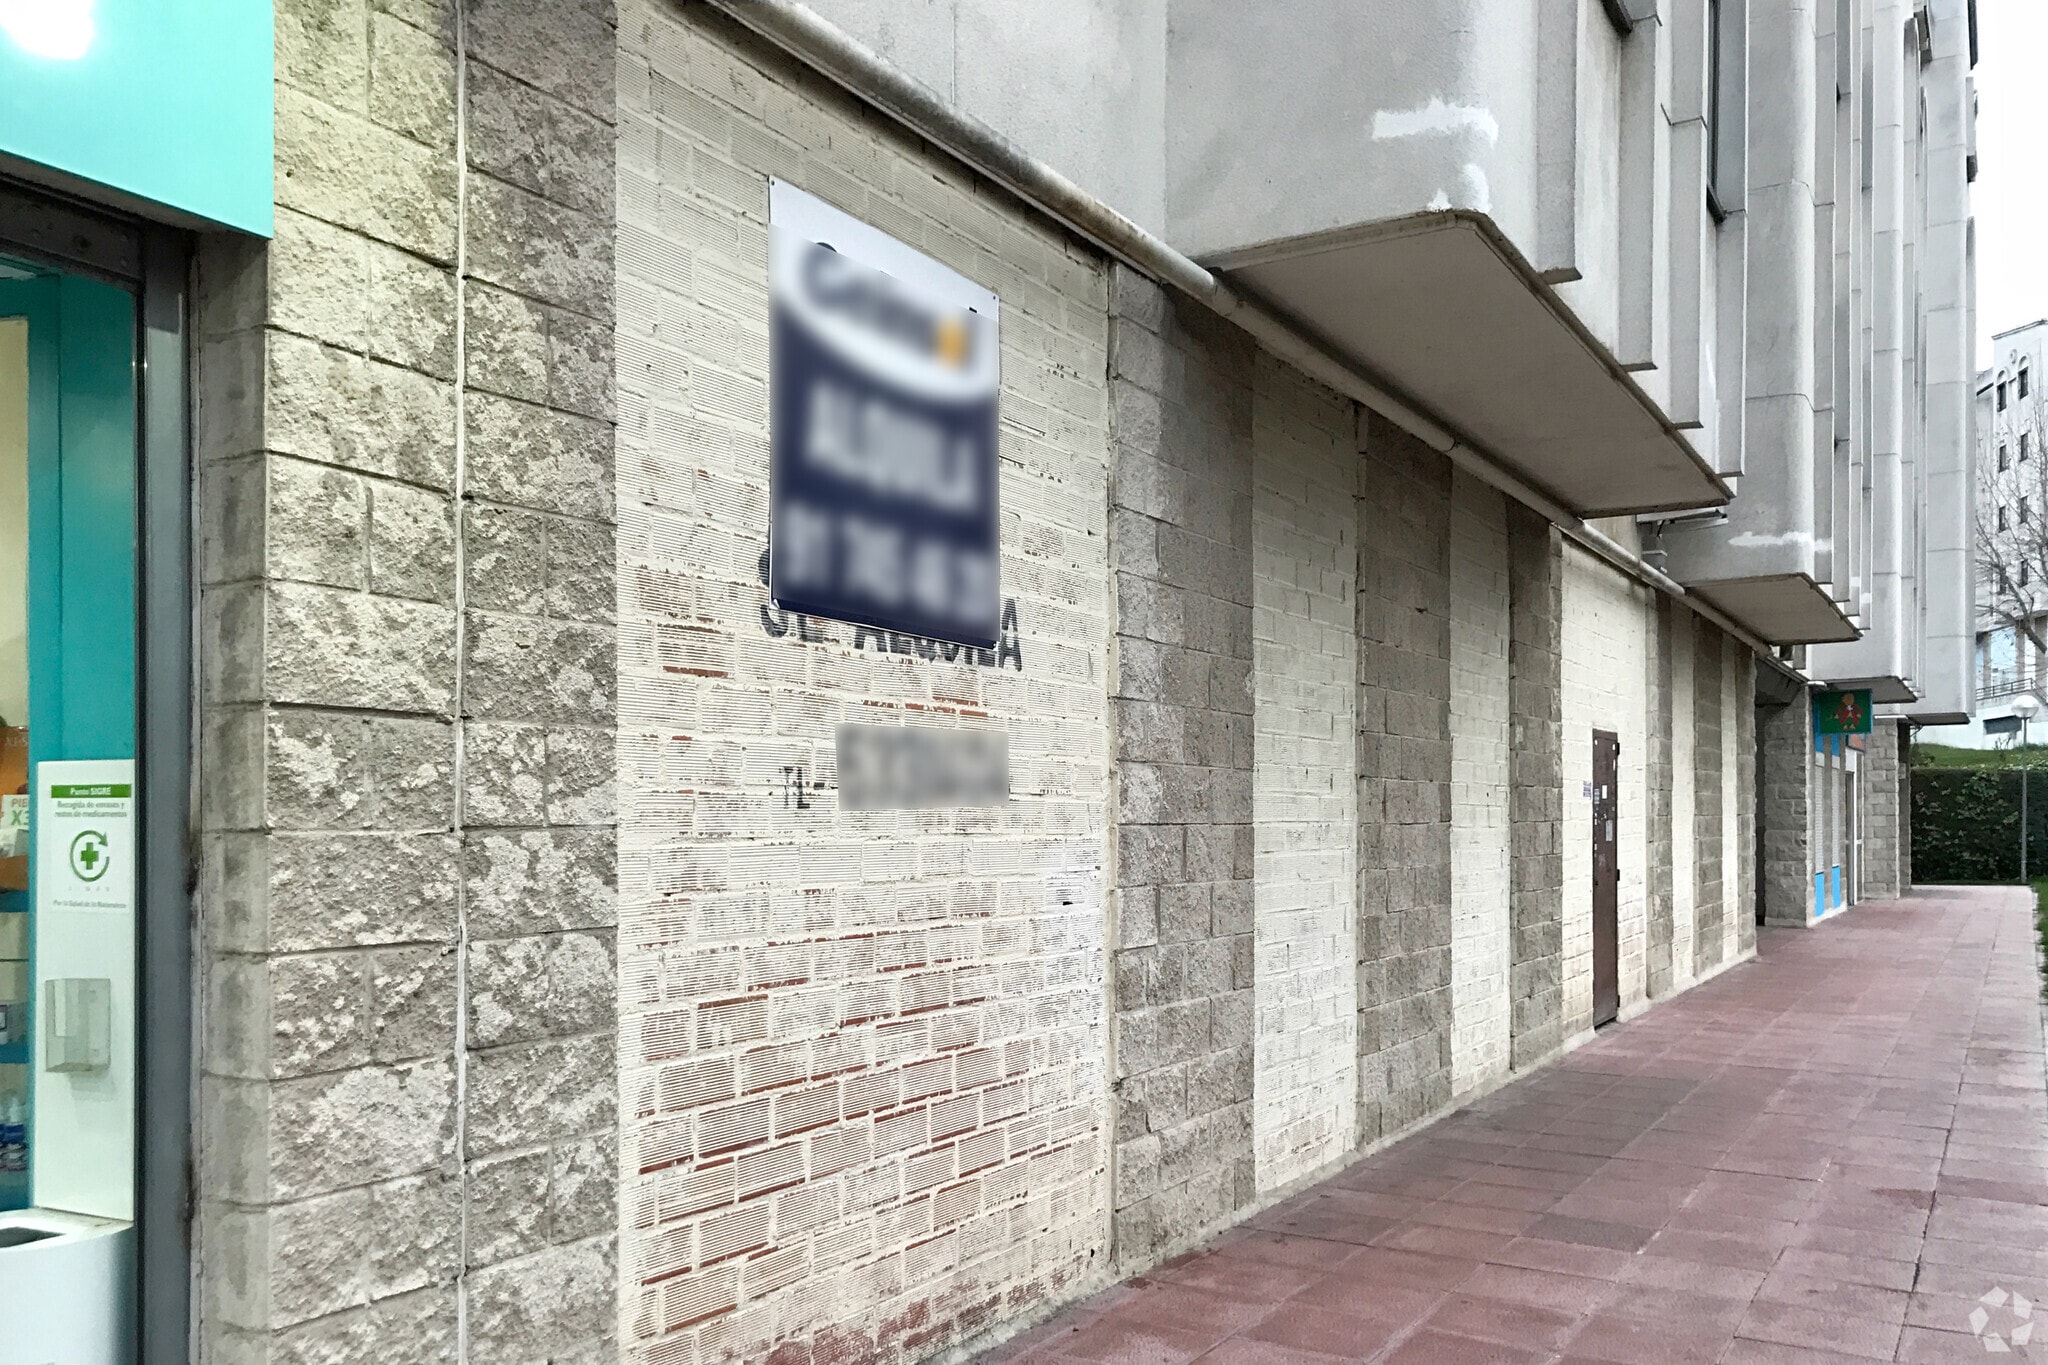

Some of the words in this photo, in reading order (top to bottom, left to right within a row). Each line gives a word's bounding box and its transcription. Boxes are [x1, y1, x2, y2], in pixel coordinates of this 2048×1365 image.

[70, 787, 89, 796] Punto
[90, 786, 111, 796] SIGRE
[57, 801, 85, 810] Recogida
[82, 810, 127, 818] medicamentos
